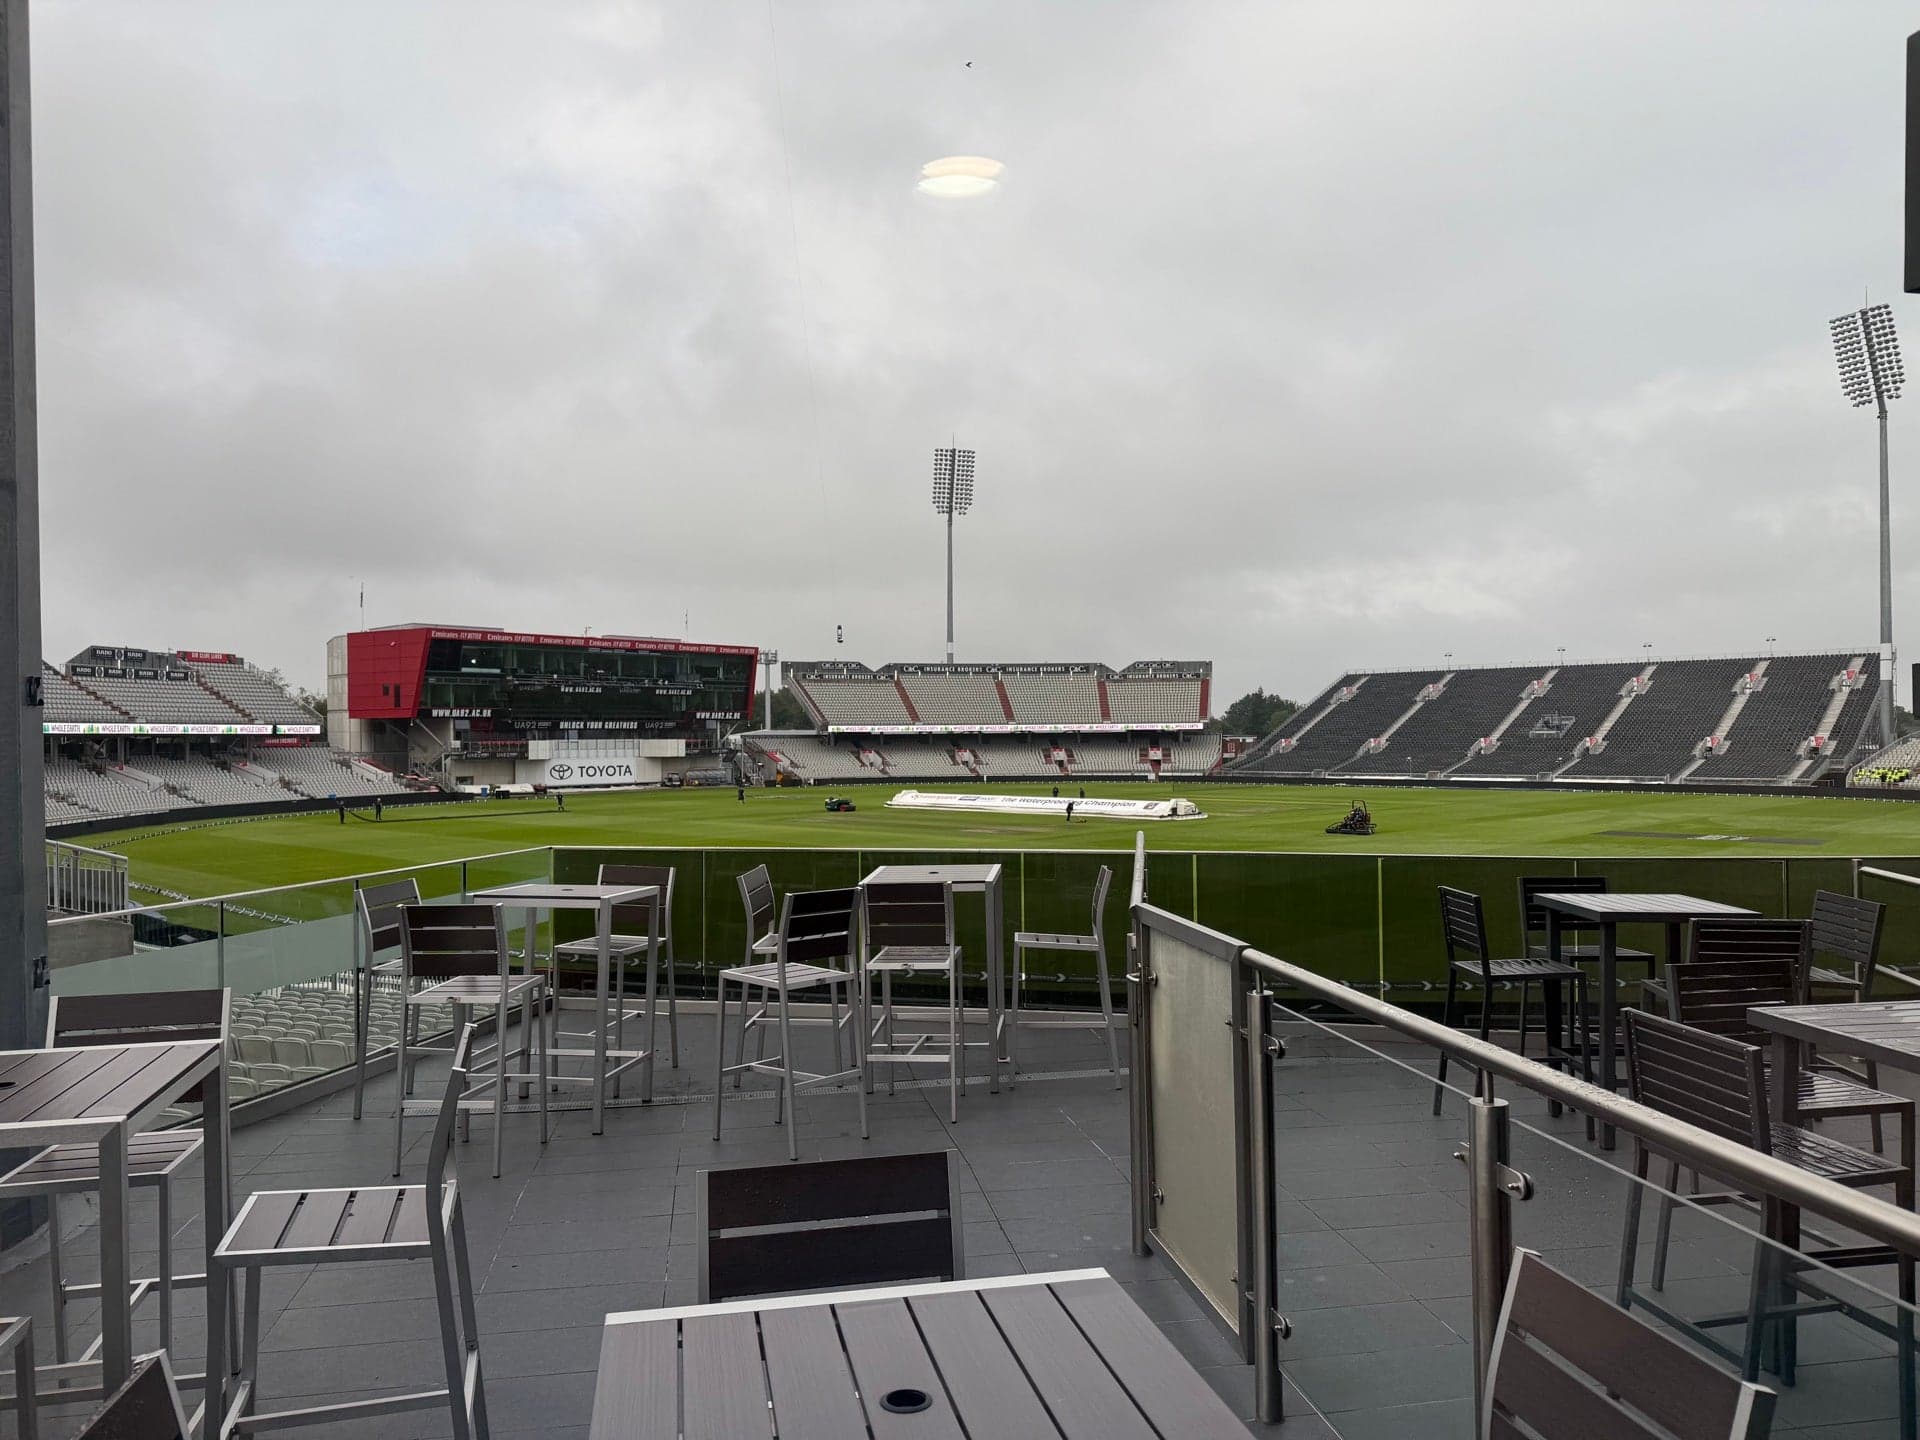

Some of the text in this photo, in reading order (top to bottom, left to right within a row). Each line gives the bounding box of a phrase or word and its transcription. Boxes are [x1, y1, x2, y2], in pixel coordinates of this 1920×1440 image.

[431, 630, 458, 639] Emirates
[432, 709, 492, 718] WWW.UA92.AC.UK
[514, 721, 536, 729] UA92
[559, 721, 584, 729] UNLOCK
[586, 721, 603, 729] YOUR
[604, 721, 638, 729] GREATNESS
[577, 764, 633, 777] TOYOTA
